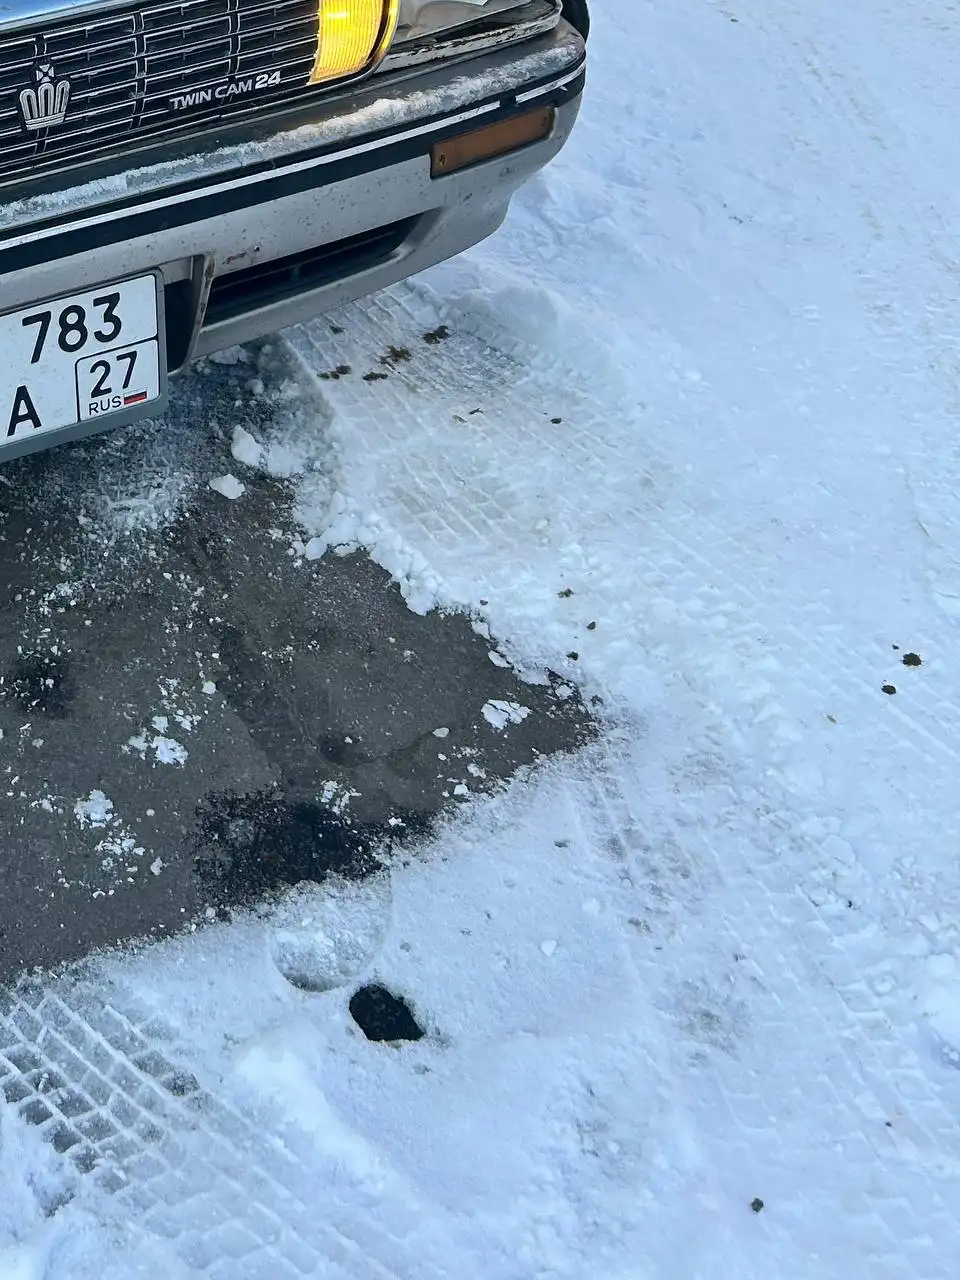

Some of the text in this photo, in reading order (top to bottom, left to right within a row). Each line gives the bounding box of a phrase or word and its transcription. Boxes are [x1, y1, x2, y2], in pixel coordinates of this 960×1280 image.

[169, 71, 282, 110] TWIN CAM 24
[21, 292, 122, 364] 783
[89, 350, 138, 399] 27
[89, 395, 122, 415] RUS
